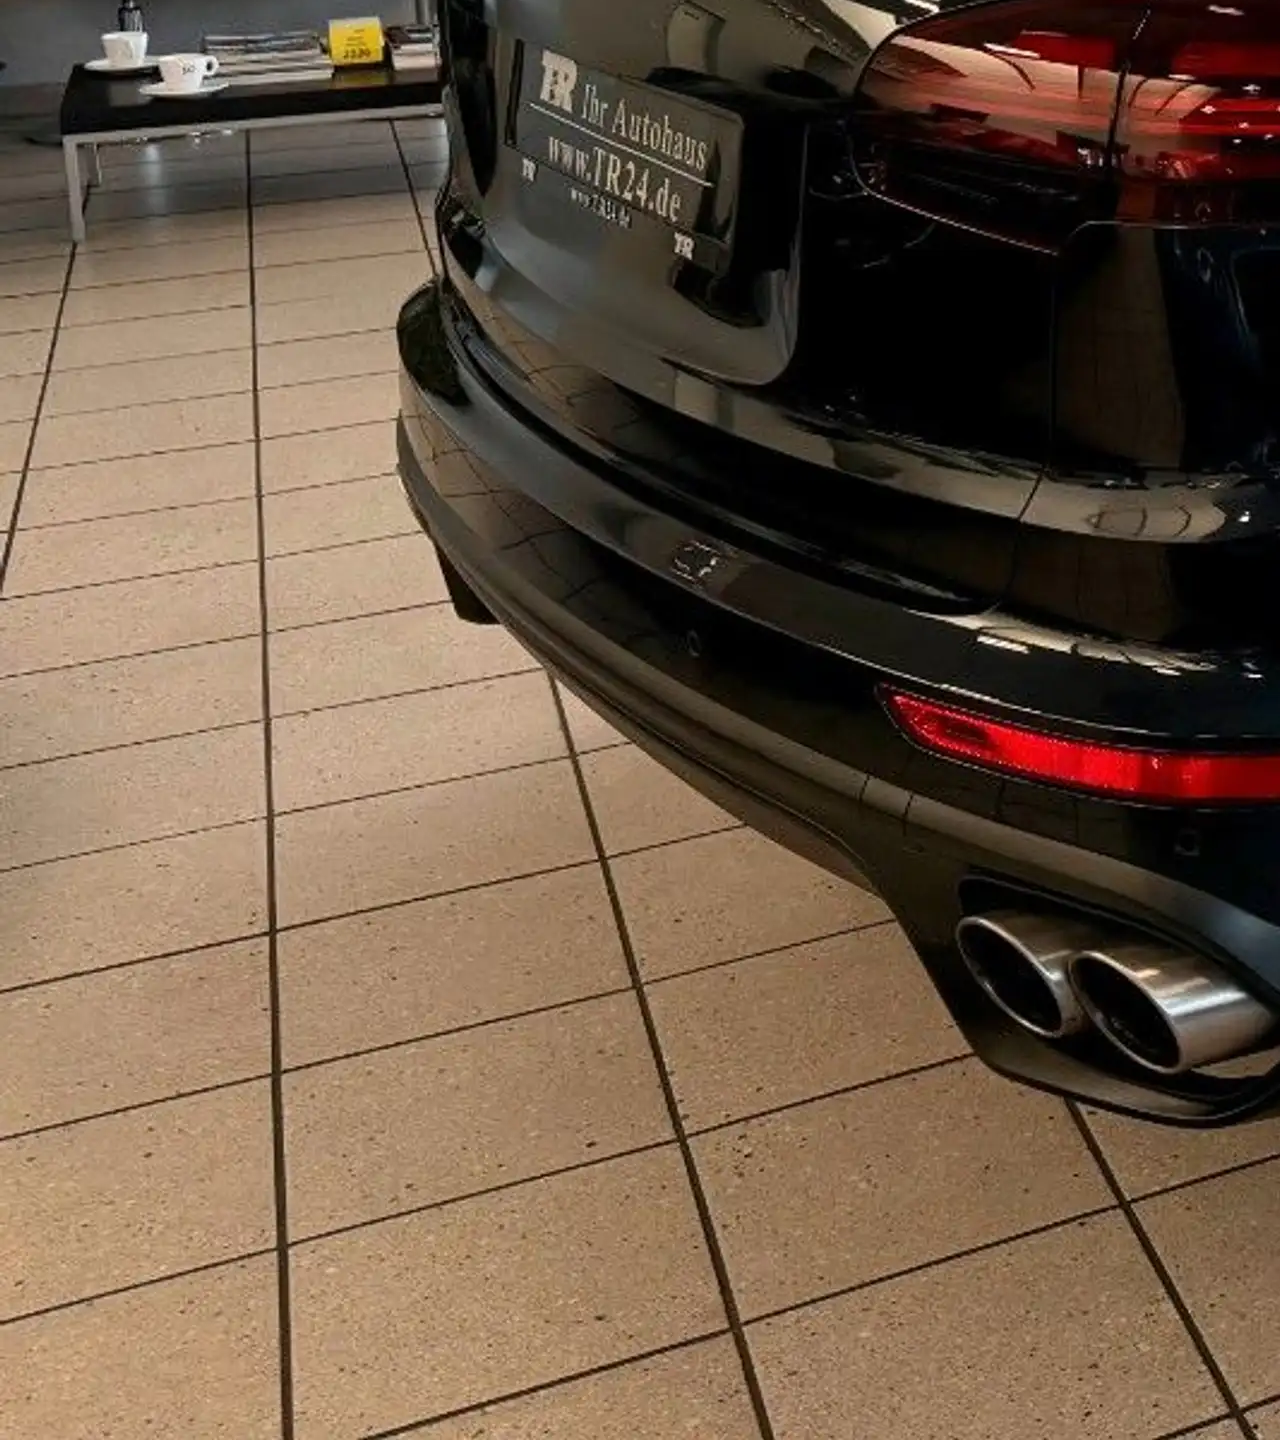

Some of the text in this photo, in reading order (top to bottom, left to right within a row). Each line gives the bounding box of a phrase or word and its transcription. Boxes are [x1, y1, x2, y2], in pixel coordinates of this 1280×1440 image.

[581, 83, 609, 129] Ihr
[612, 97, 708, 173] Autohaus
[549, 136, 682, 223] www.TR24.de
